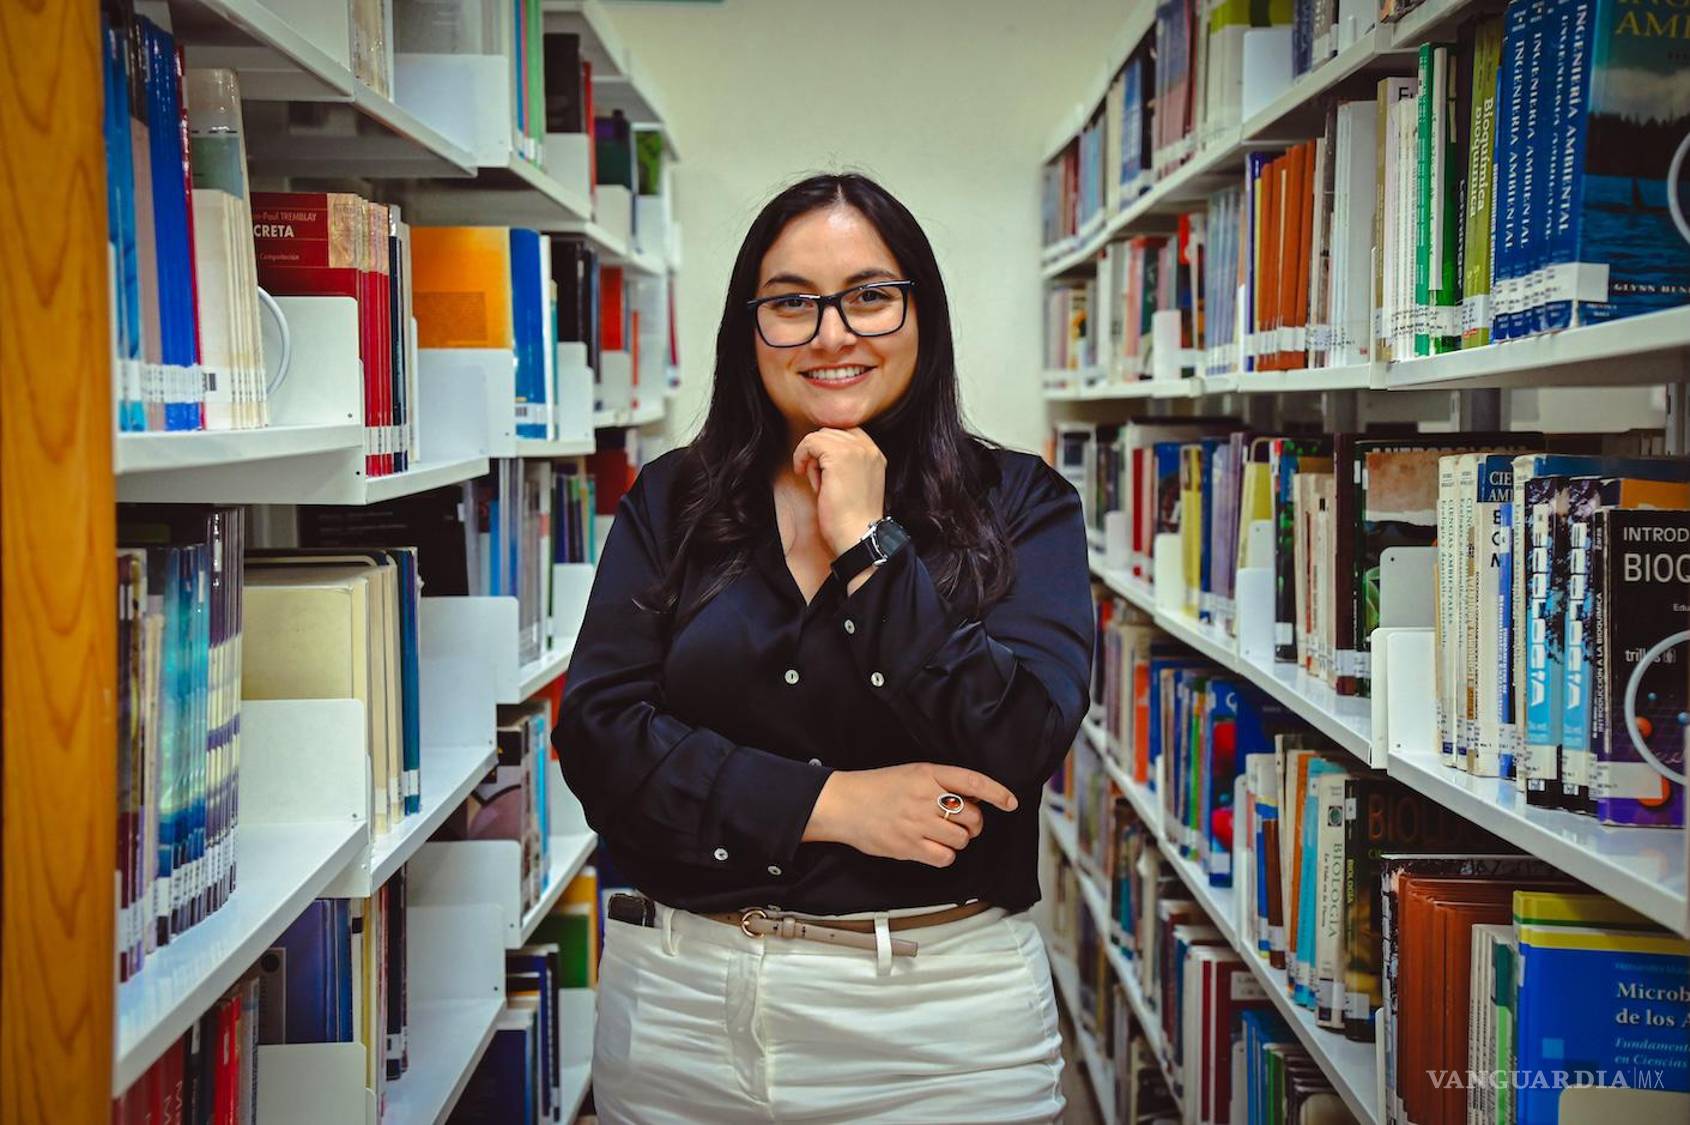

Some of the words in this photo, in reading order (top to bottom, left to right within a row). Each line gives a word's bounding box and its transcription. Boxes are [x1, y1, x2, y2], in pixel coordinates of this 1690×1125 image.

[253, 224, 295, 238] CRETA
[1613, 283, 1656, 292] GLYNN
[1615, 1008, 1640, 1024] de
[1646, 1009, 1676, 1027] los
